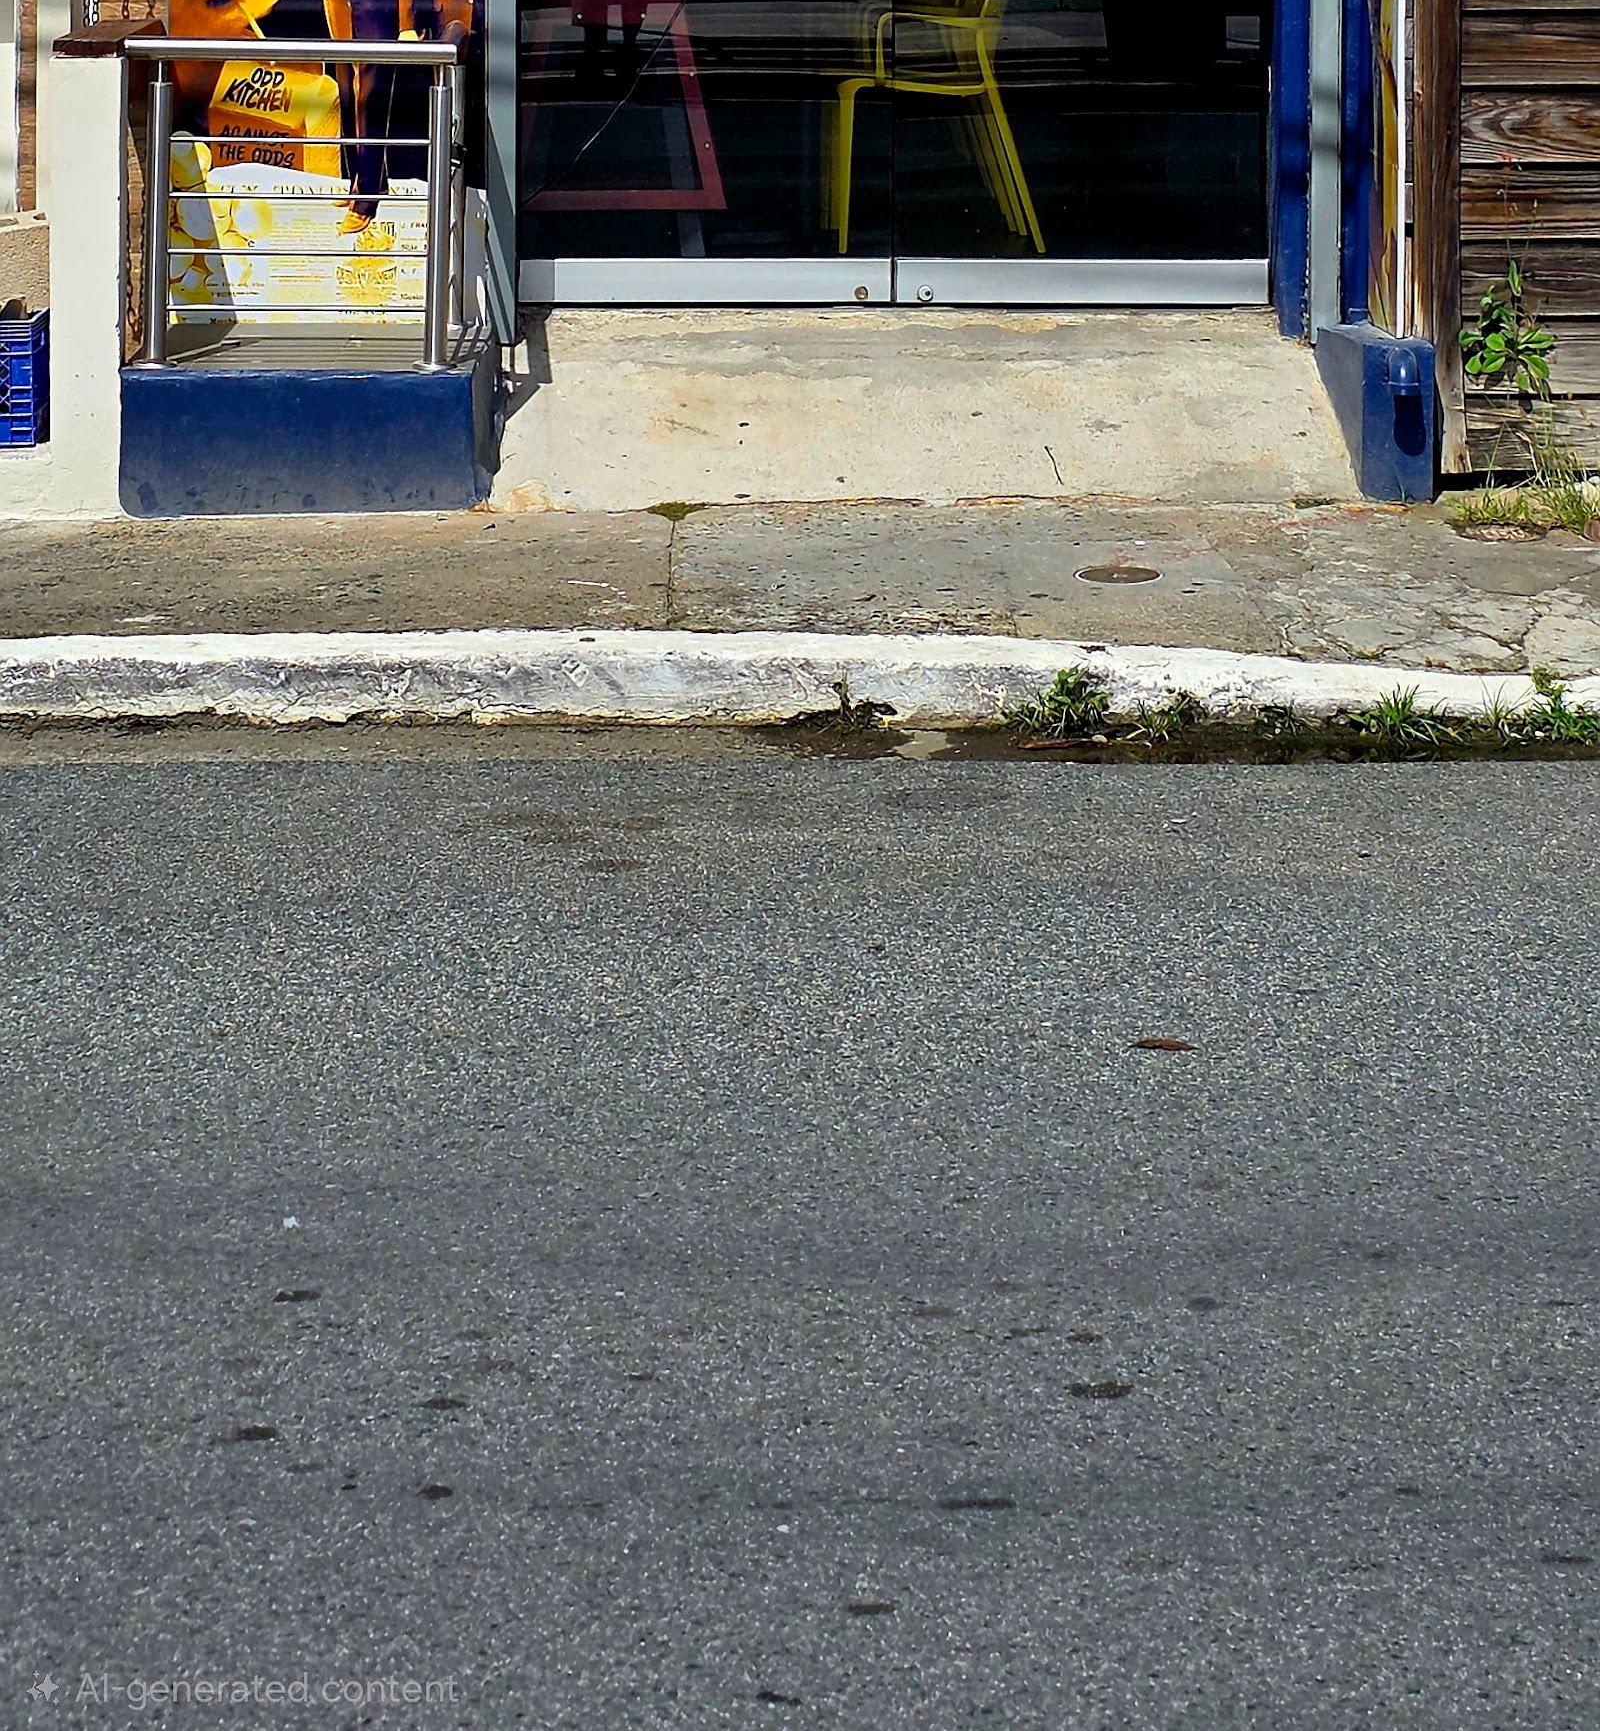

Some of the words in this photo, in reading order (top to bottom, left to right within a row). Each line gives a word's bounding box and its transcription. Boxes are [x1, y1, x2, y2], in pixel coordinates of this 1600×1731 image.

[250, 67, 285, 88] ODD
[221, 78, 293, 113] KITCHEN
[218, 144, 246, 161] THE
[251, 148, 296, 169] ODDS
